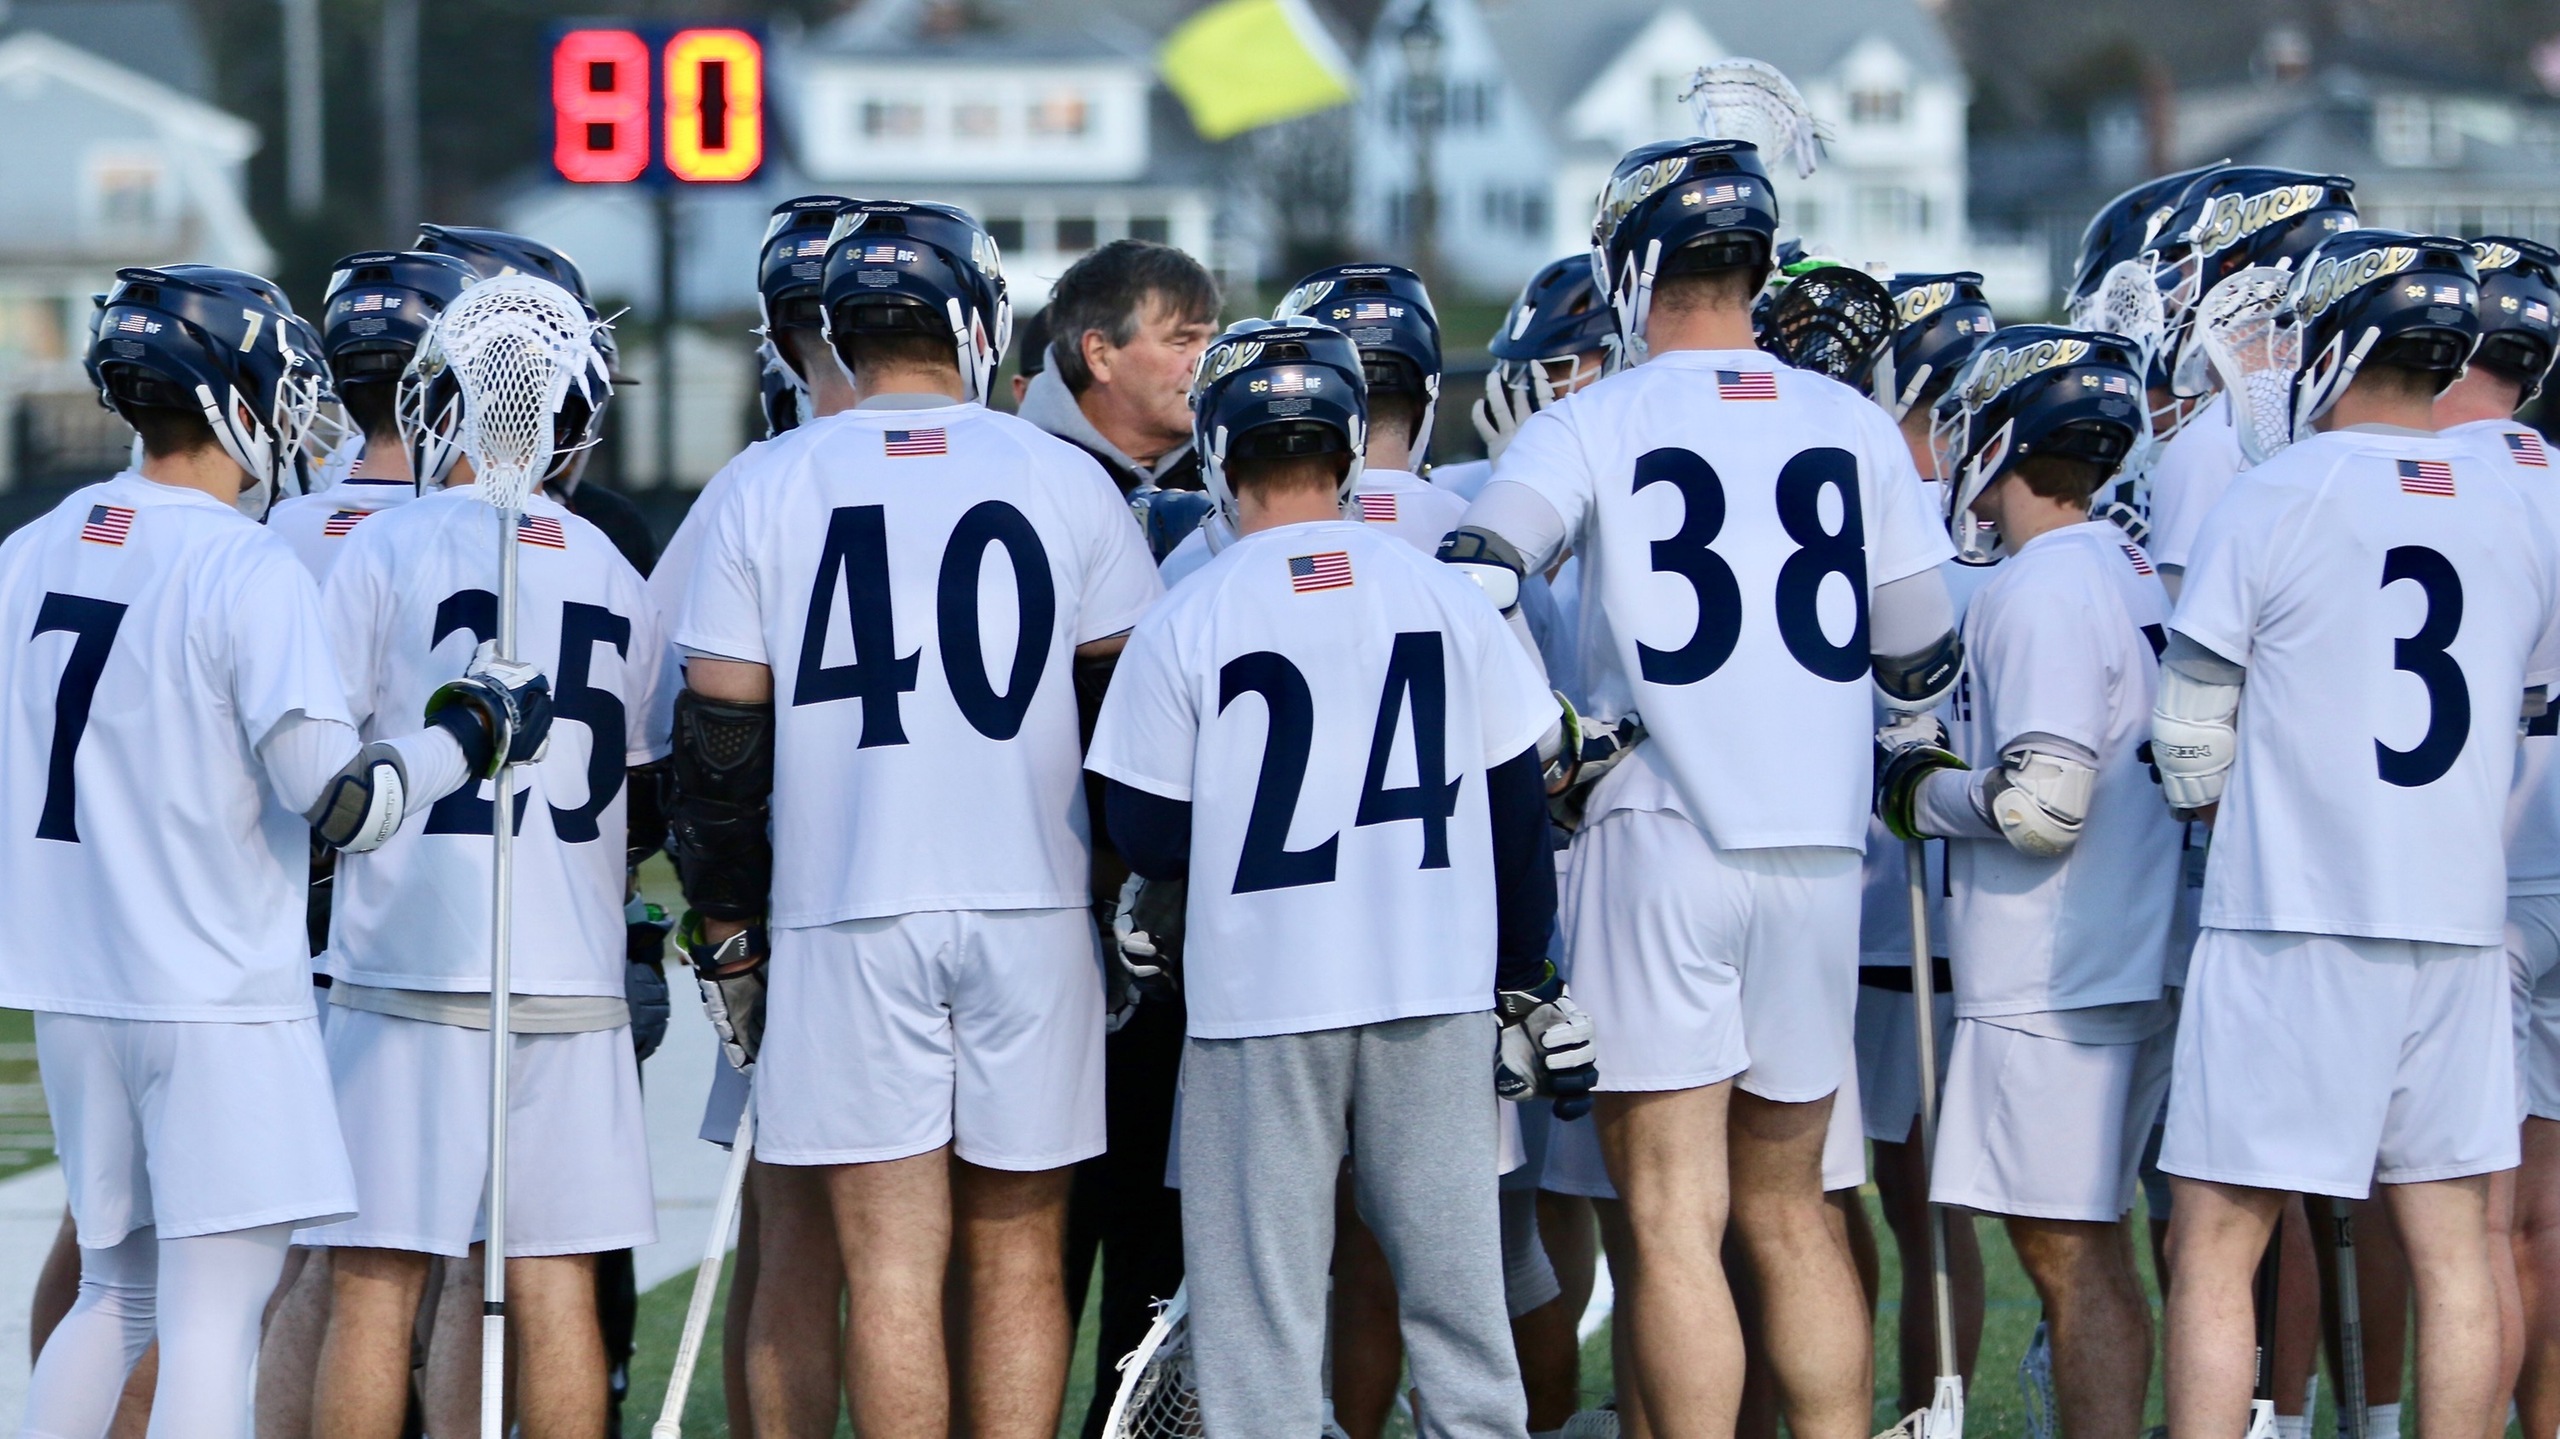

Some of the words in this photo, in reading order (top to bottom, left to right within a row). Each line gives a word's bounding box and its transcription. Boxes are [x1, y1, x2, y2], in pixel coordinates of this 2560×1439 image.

[553, 29, 763, 183] 80
[794, 200, 841, 208] cascade
[861, 205, 911, 213] cascade
[846, 248, 862, 260] SC
[897, 250, 914, 261] RF
[384, 297, 402, 309] RF
[1333, 308, 1350, 320] SC
[1389, 307, 1404, 318] RF
[145, 322, 162, 334] RF
[239, 308, 264, 353] 7
[1258, 331, 1310, 340] cascade
[1250, 380, 1268, 393] SC
[1305, 378, 1321, 390] RF
[2082, 375, 2099, 387] SC
[1632, 447, 1871, 685] 38
[792, 500, 1056, 749] 40
[2373, 545, 2471, 787] 3
[31, 592, 128, 843] 7
[422, 588, 631, 844] 25
[1218, 631, 1463, 895] 24
